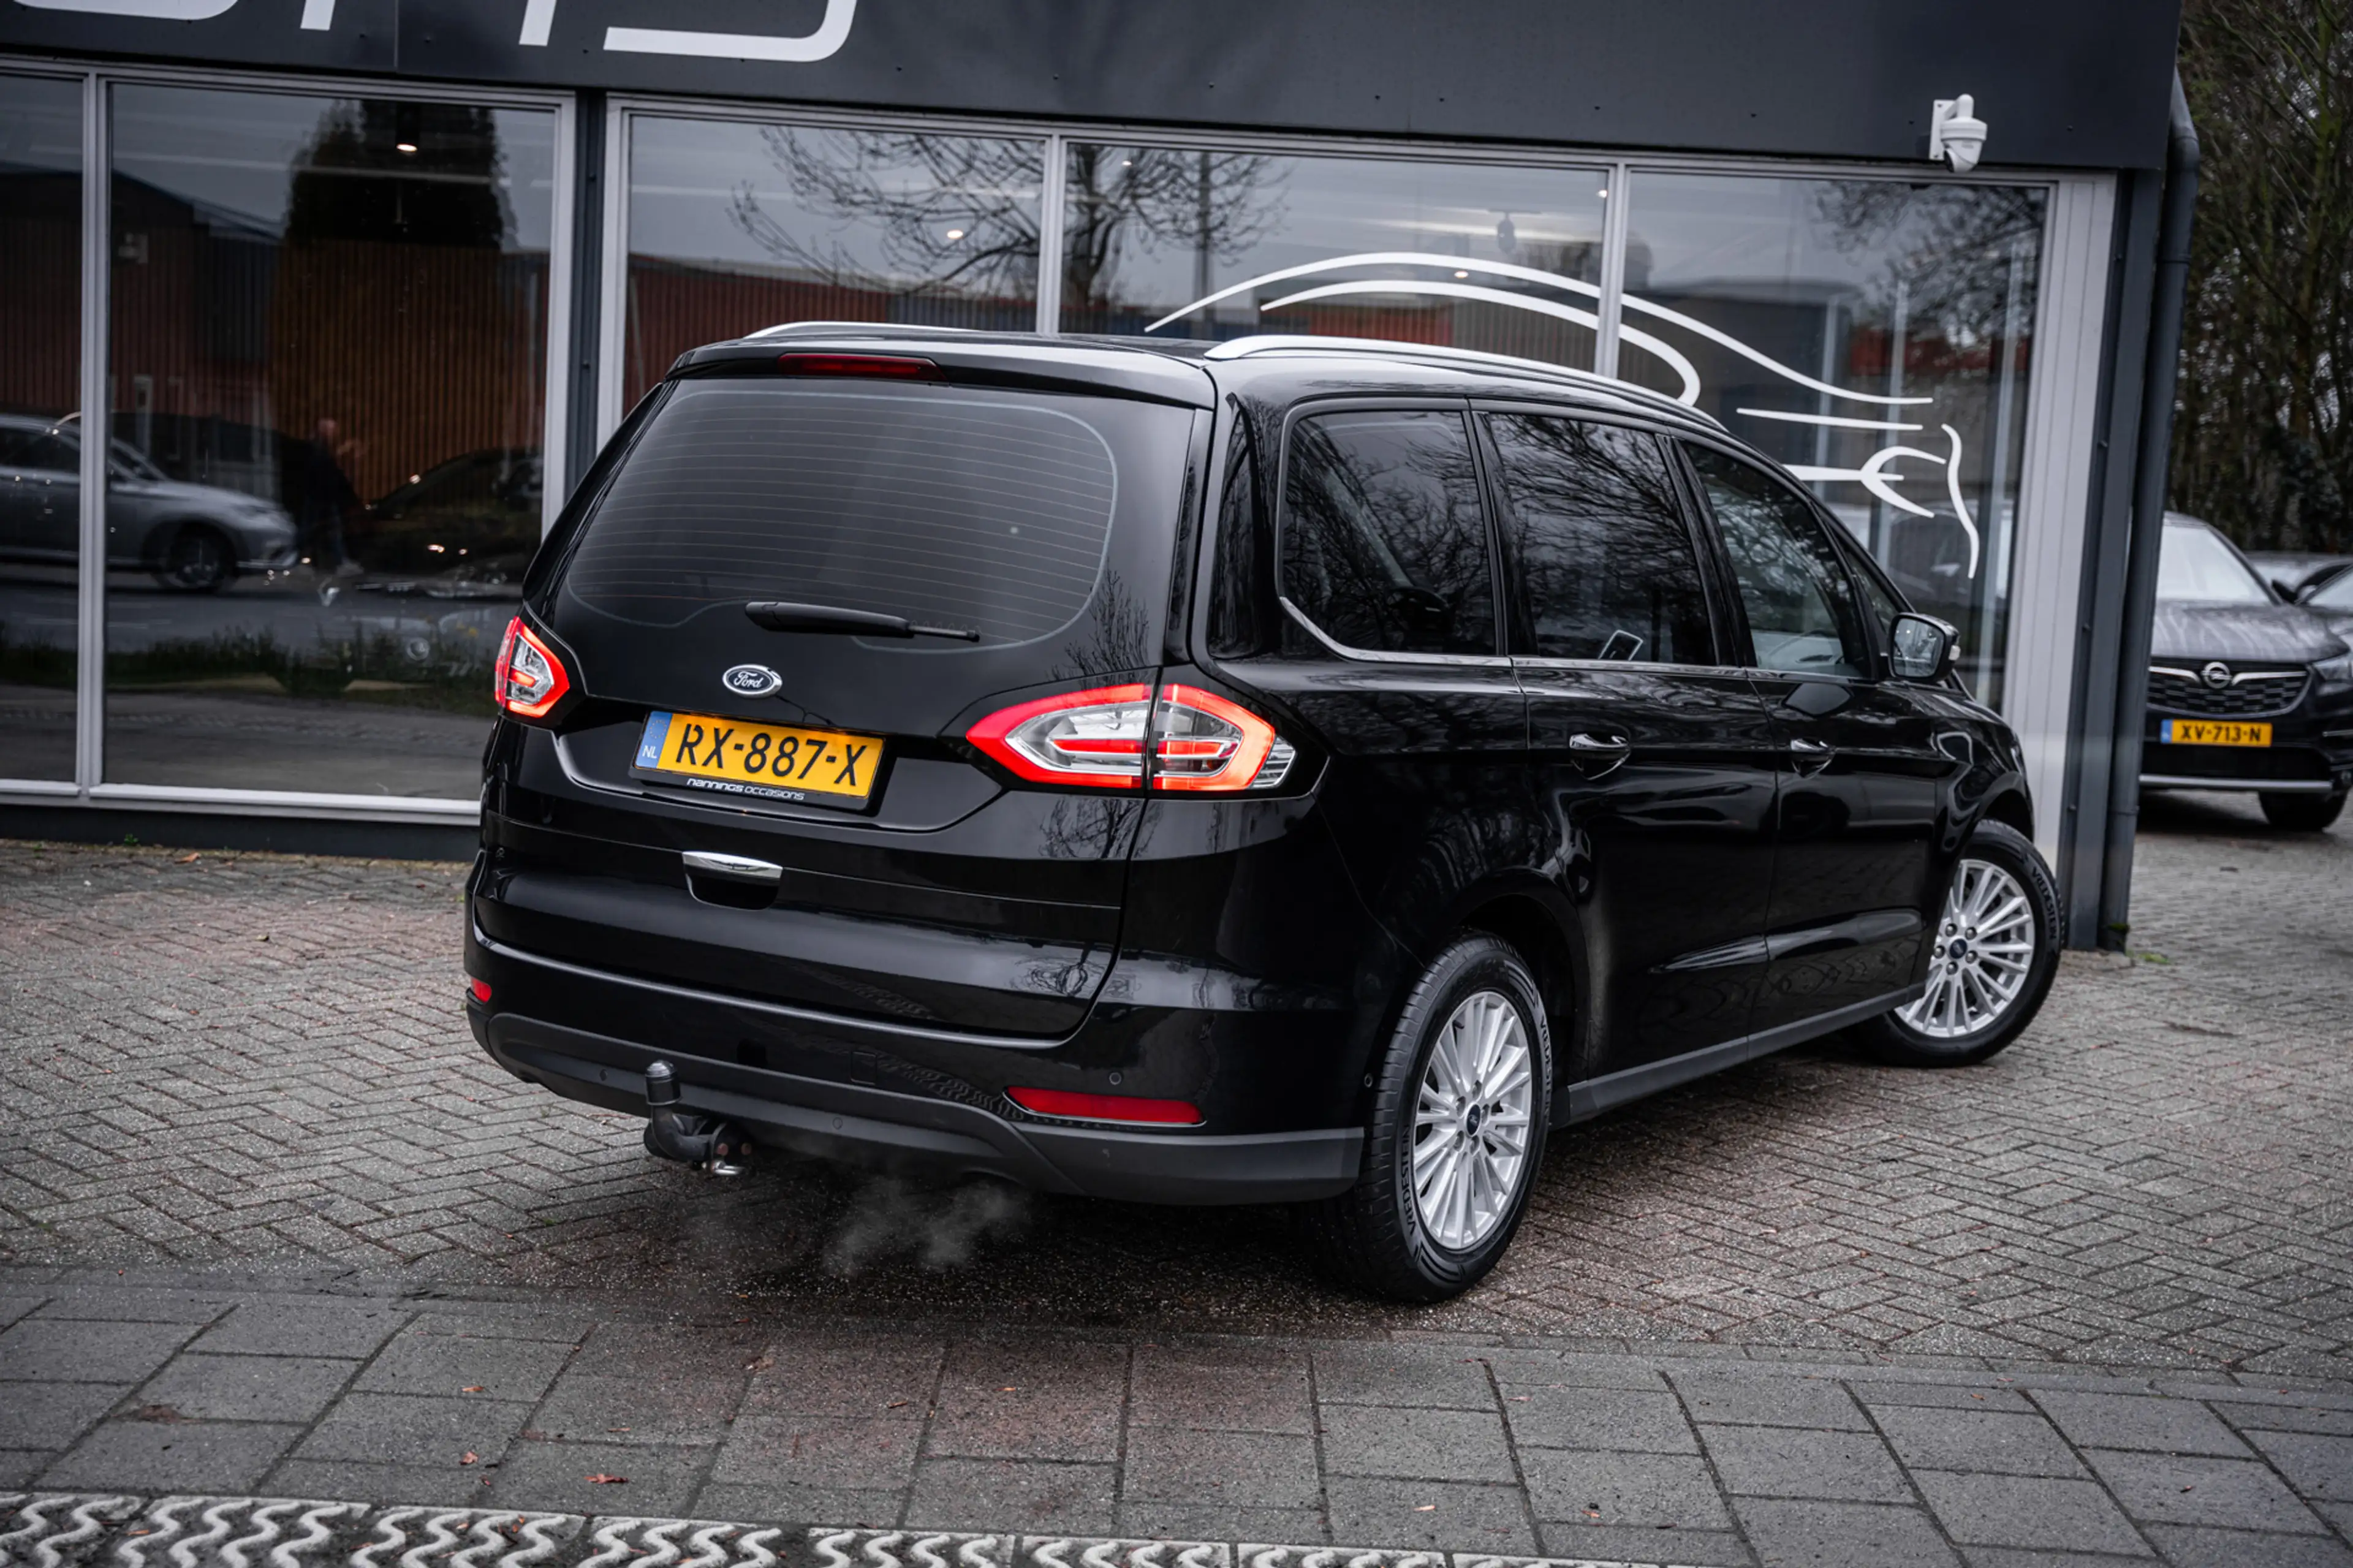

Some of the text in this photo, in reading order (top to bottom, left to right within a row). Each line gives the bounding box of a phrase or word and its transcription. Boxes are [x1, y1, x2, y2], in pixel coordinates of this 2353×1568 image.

[733, 671, 764, 687] Ford
[2181, 725, 2261, 743] XV-713-N
[642, 745, 657, 760] NL
[675, 723, 867, 787] RX-887-X
[744, 785, 806, 801] occasions
[1402, 1126, 1416, 1235] VREDESTEIN
